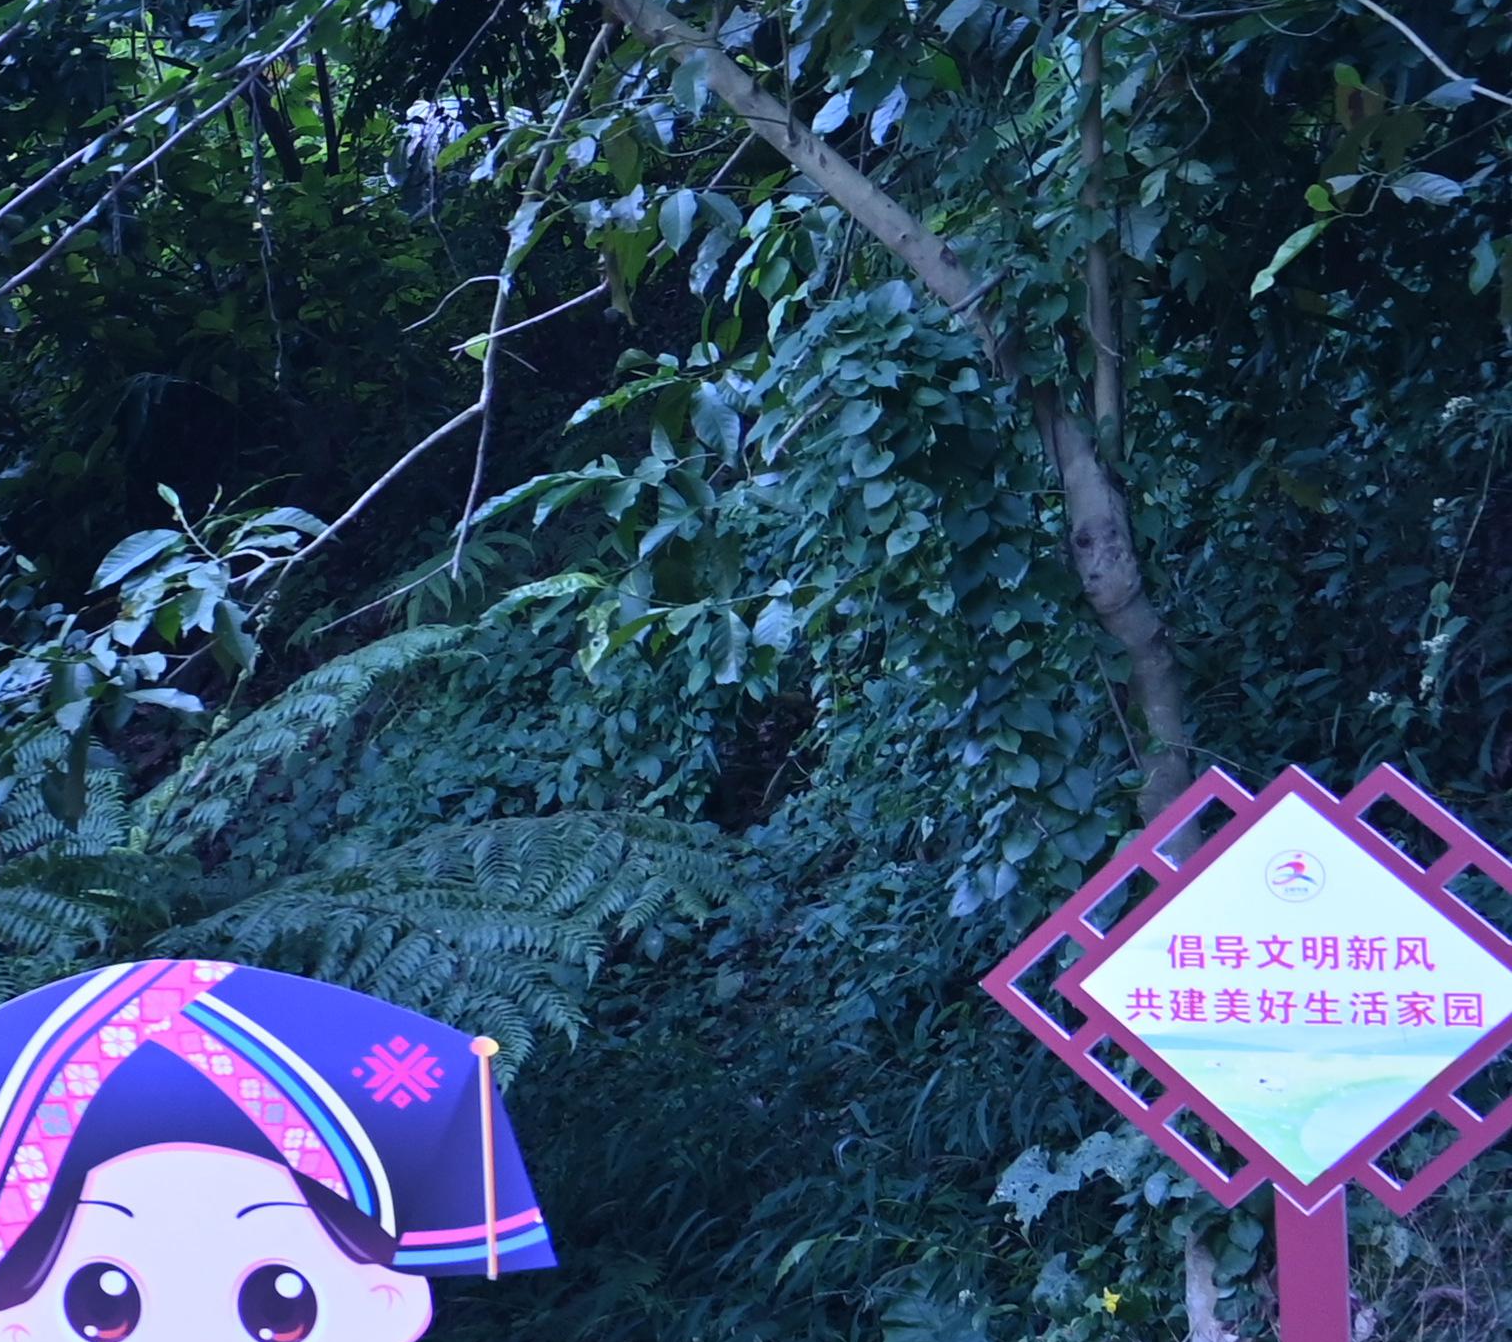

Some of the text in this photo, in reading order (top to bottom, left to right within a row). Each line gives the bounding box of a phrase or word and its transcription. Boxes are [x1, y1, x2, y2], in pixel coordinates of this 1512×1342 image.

[1166, 932, 1437, 972] 倡导文明新风
[1125, 986, 1485, 1029] 共建美好生活家园
